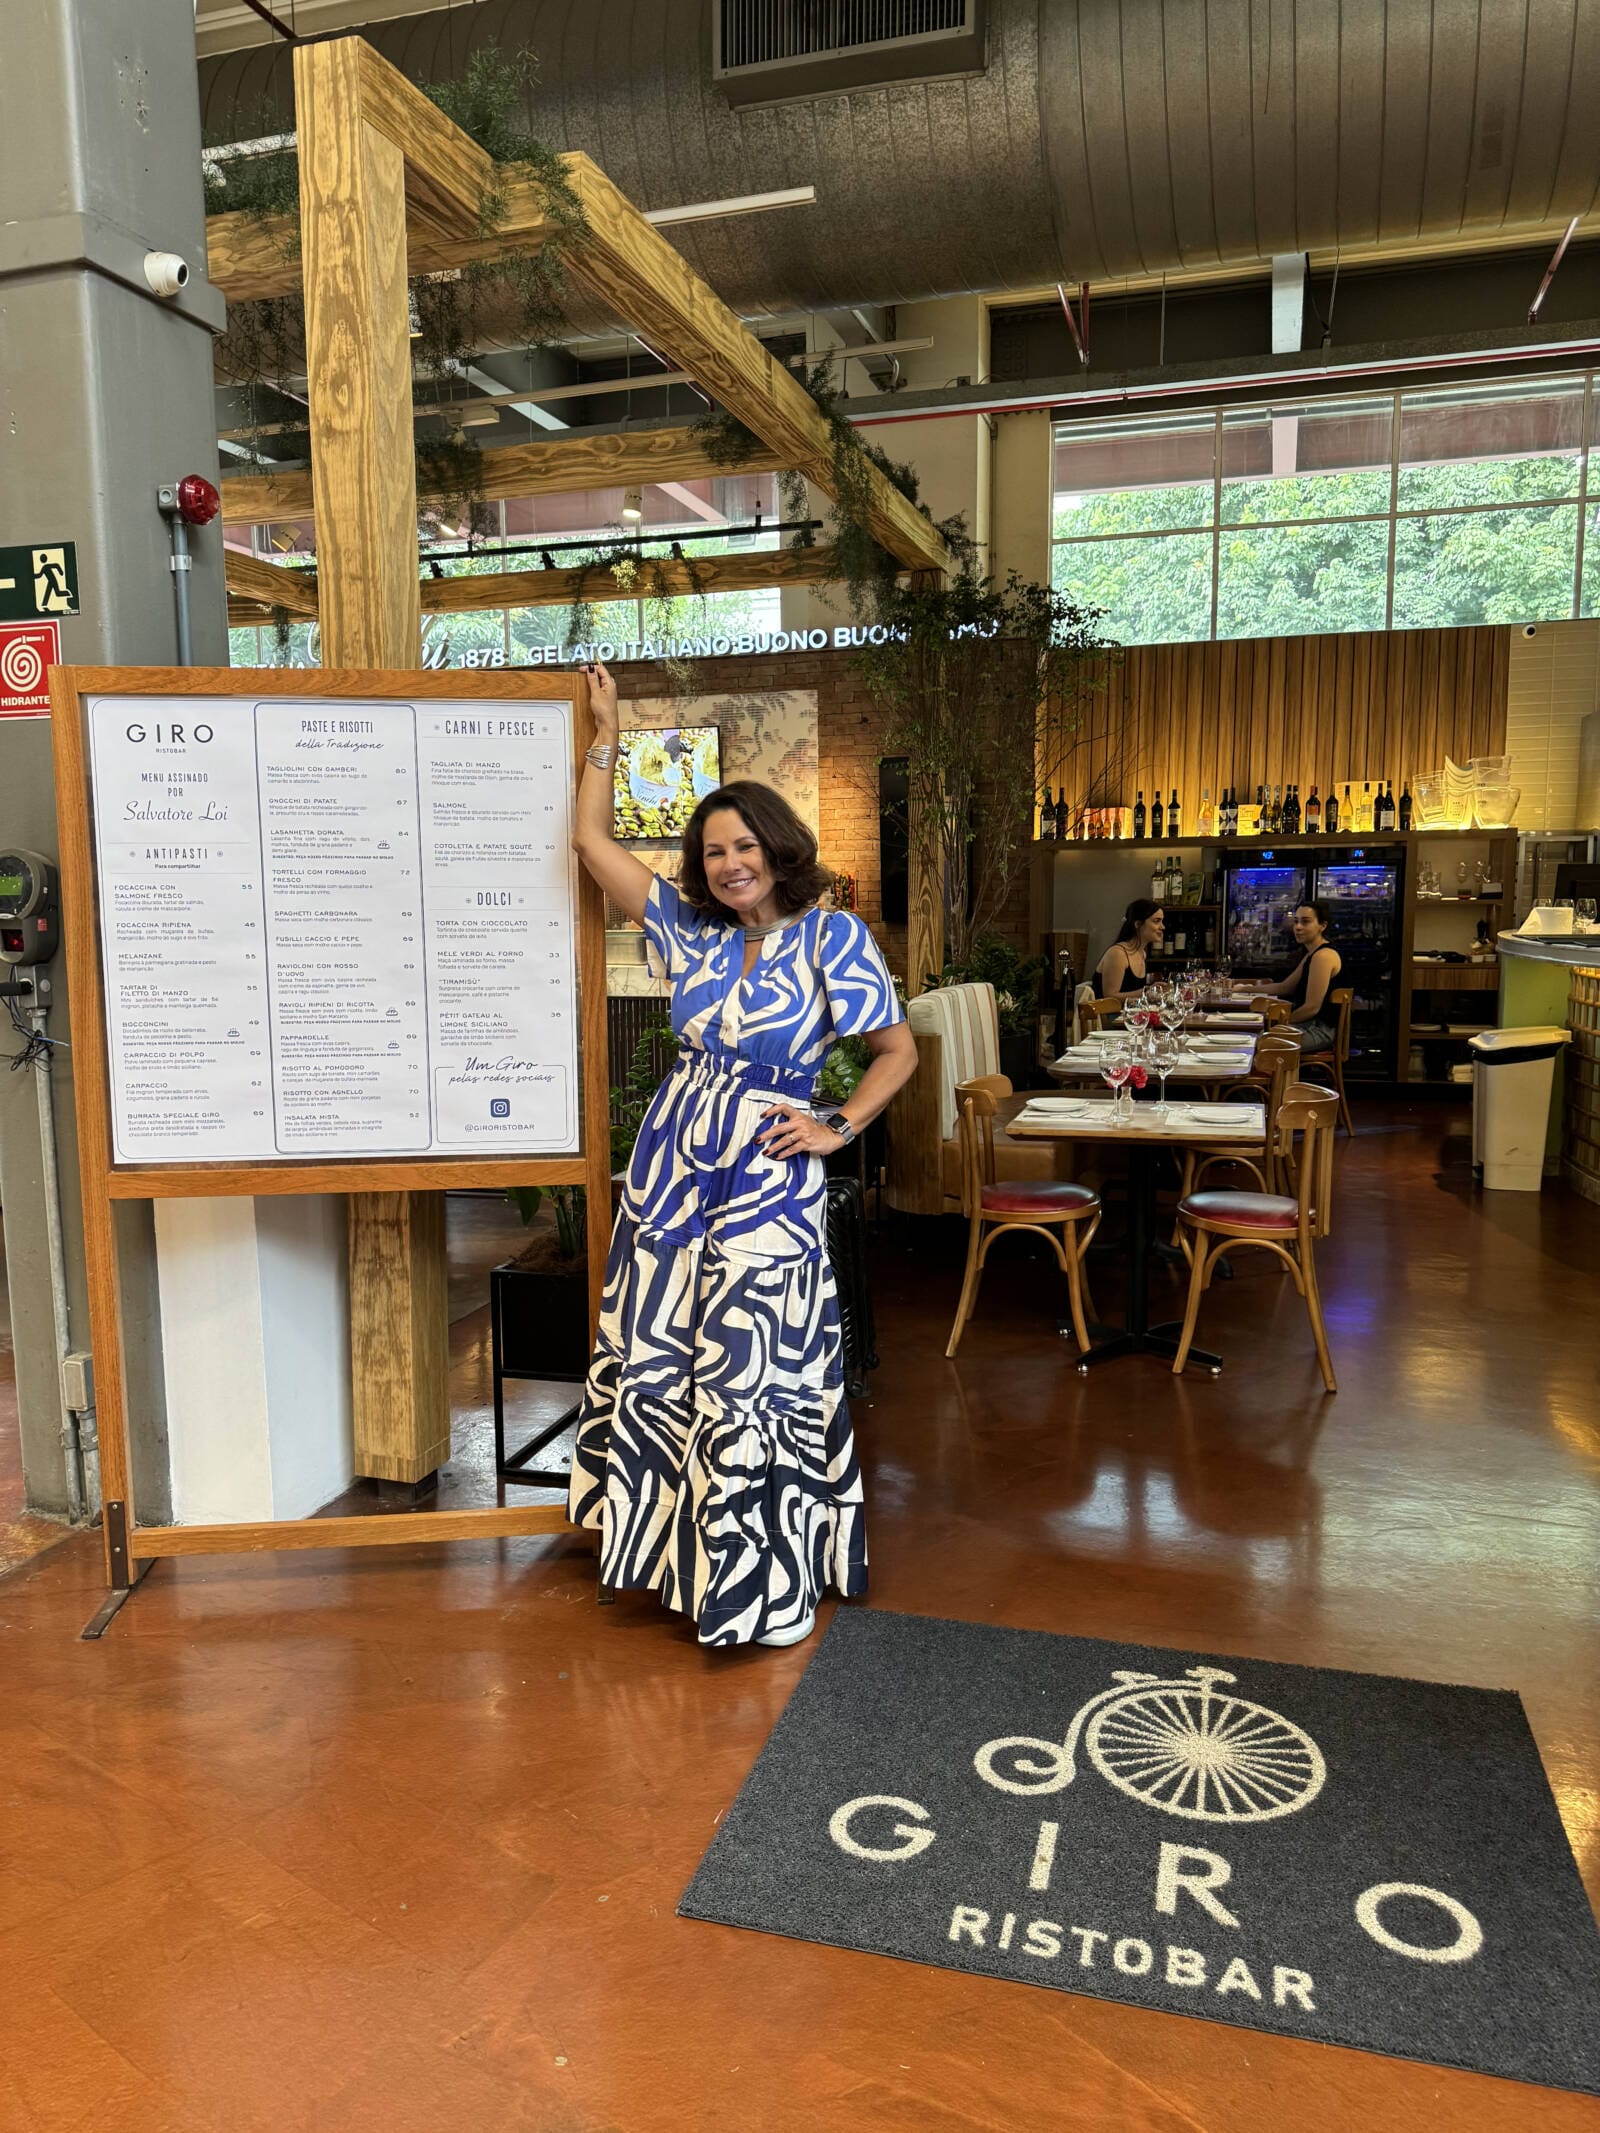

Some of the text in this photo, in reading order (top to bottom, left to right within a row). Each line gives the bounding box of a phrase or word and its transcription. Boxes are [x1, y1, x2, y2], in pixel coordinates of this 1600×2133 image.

[457, 647, 506, 669] 1878
[527, 641, 615, 665] GELATO
[622, 634, 731, 660] ITALIANO
[738, 628, 828, 654] BUONO
[1, 696, 51, 706] HIDRANTE
[126, 723, 214, 743] GIRO
[301, 720, 373, 733] PASTE E RISOTTI
[445, 720, 535, 736] CARNI E PESCE
[295, 738, 384, 752] della Tradizione
[141, 773, 209, 783] MENU ASSINADO
[168, 787, 184, 797] POR
[123, 800, 228, 821] Salvatore Loi
[146, 848, 209, 860] ANTIPASTI
[477, 892, 511, 906] DOLCI
[465, 1055, 539, 1071] Um Giro
[448, 1072, 480, 1085] pelas
[483, 1073, 514, 1083] redes
[464, 1123, 535, 1132] @GIRORISTOBAR
[829, 1795, 1484, 1964] GIRO
[948, 1904, 1317, 2012] RISTOBAR
